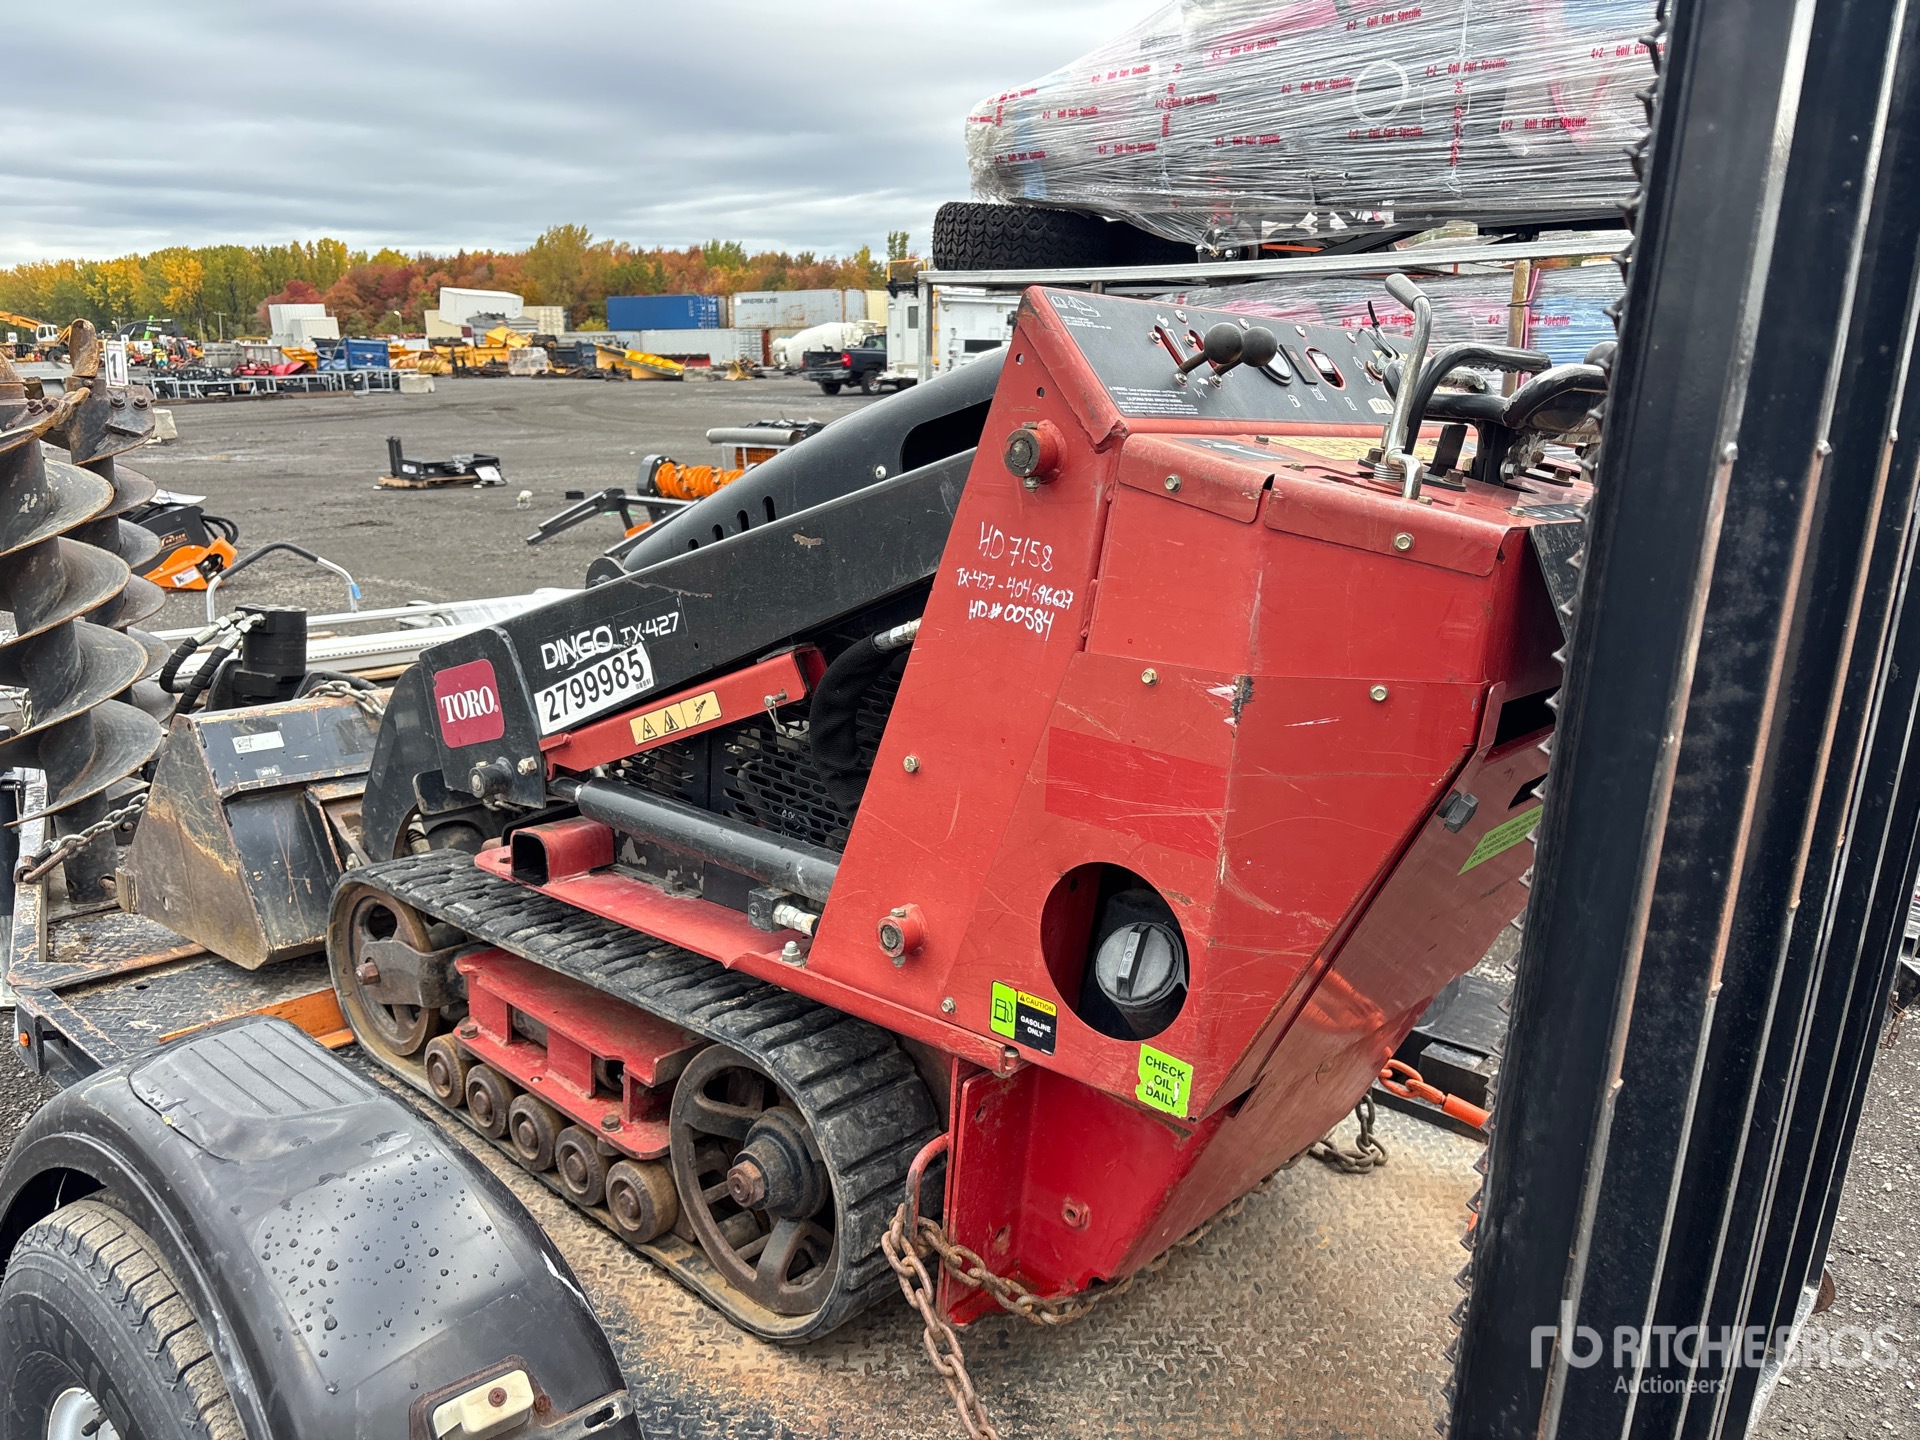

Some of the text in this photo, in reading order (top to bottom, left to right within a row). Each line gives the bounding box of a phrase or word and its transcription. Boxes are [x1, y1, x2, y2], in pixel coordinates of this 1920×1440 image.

[1591, 47, 1604, 58] 4+2
[1615, 44, 1630, 57] Golf
[1501, 117, 1587, 130] 4+2 Golf Cart Specific
[541, 625, 614, 671] DINGO
[543, 648, 645, 723] 2799985
[1025, 997, 1054, 1013] CAUTION
[1020, 1015, 1051, 1033] GASOLINE
[1026, 1026, 1044, 1038] ONLY
[1145, 1055, 1186, 1082] CHECK
[1153, 1074, 1173, 1091] OIL
[1145, 1085, 1178, 1108] DAILY
